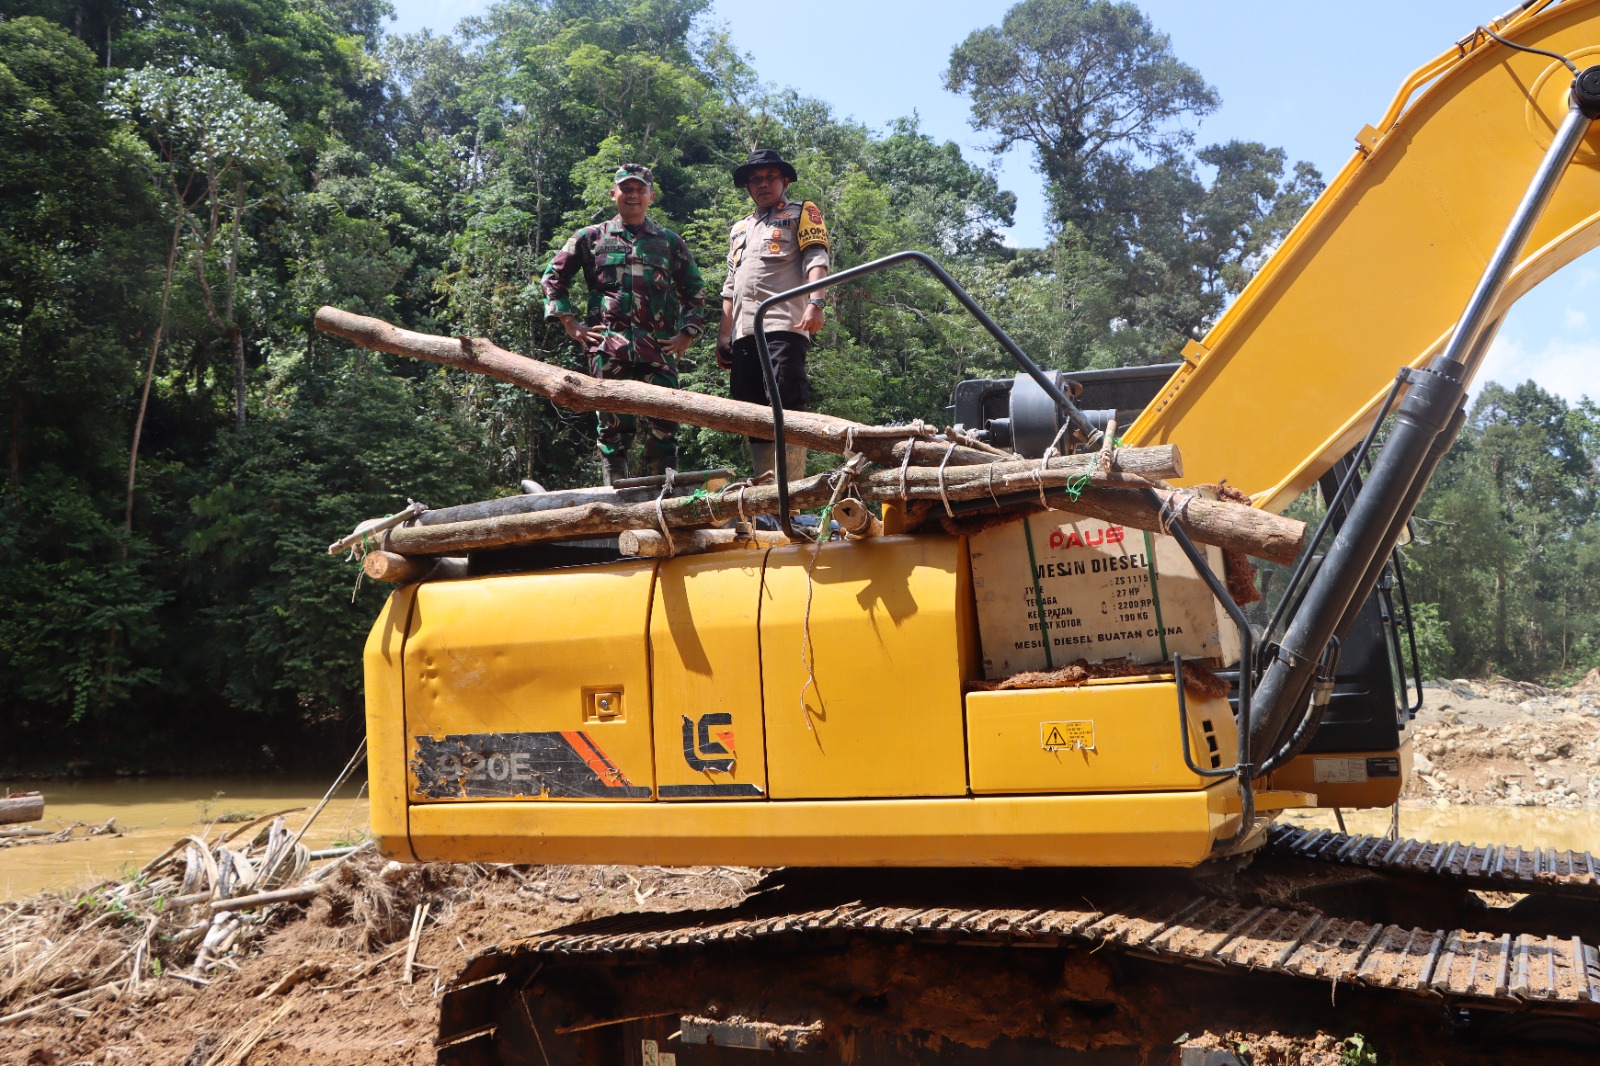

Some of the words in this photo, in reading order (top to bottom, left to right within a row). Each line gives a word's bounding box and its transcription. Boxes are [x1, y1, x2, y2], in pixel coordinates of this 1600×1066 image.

[1049, 525, 1124, 550] PAUS
[1092, 554, 1148, 573] DIESEL
[1025, 586, 1044, 595] TYE
[1116, 589, 1126, 597] 27
[1129, 587, 1140, 596] HP
[1118, 601, 1139, 610] 2200
[1056, 618, 1082, 629] KOTOR
[1120, 613, 1135, 622] 190
[1137, 612, 1148, 620] KG
[1054, 634, 1093, 646] DIESEL
[1097, 630, 1142, 642] BUATAN
